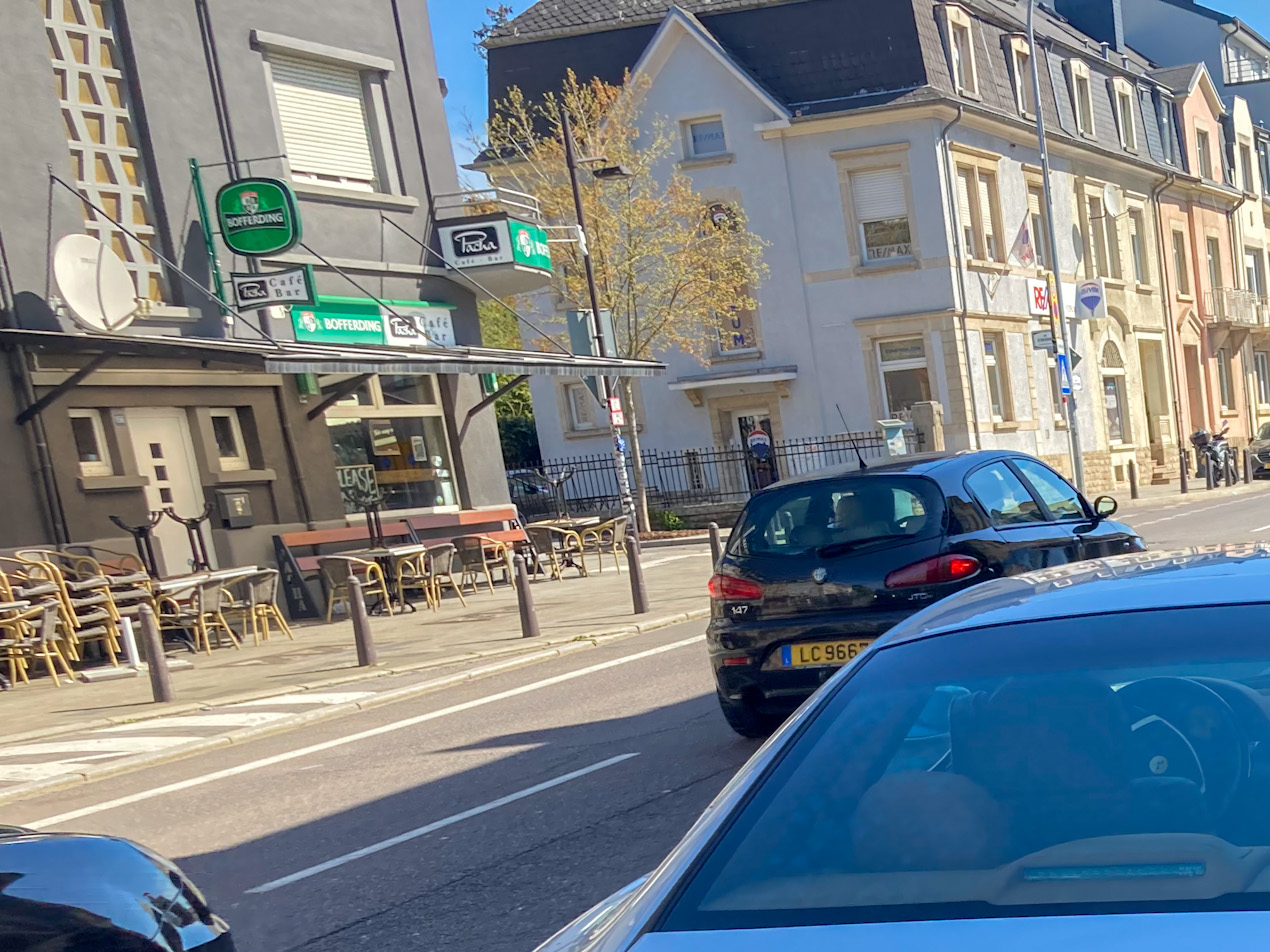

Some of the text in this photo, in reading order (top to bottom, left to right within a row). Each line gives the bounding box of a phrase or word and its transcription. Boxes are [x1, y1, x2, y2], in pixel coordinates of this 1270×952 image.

[226, 212, 283, 228] BOFFERDING
[454, 230, 498, 254] Pacha
[269, 275, 303, 287] Café
[274, 288, 301, 298] Bar
[323, 317, 382, 332] BOFFERDING
[731, 605, 748, 615] 147
[800, 648, 820, 662] LC
